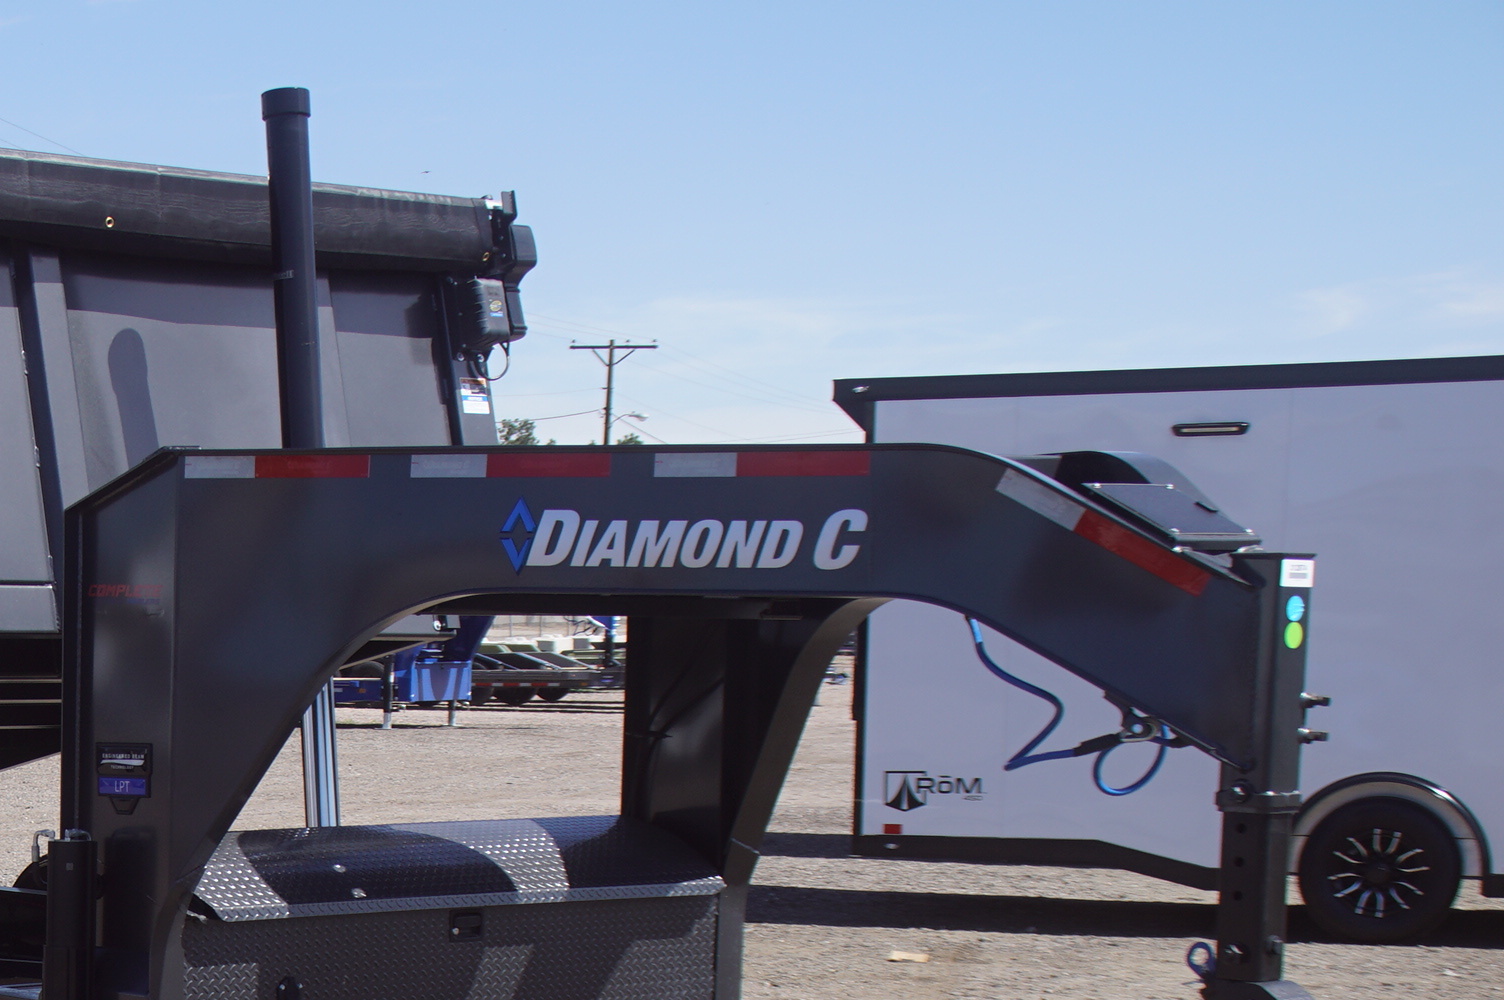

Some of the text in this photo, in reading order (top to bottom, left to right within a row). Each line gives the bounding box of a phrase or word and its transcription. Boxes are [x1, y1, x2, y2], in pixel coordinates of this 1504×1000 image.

[526, 508, 869, 571] DIAMOND C
[88, 584, 163, 598] COMPLETE
[114, 780, 131, 793] LPT
